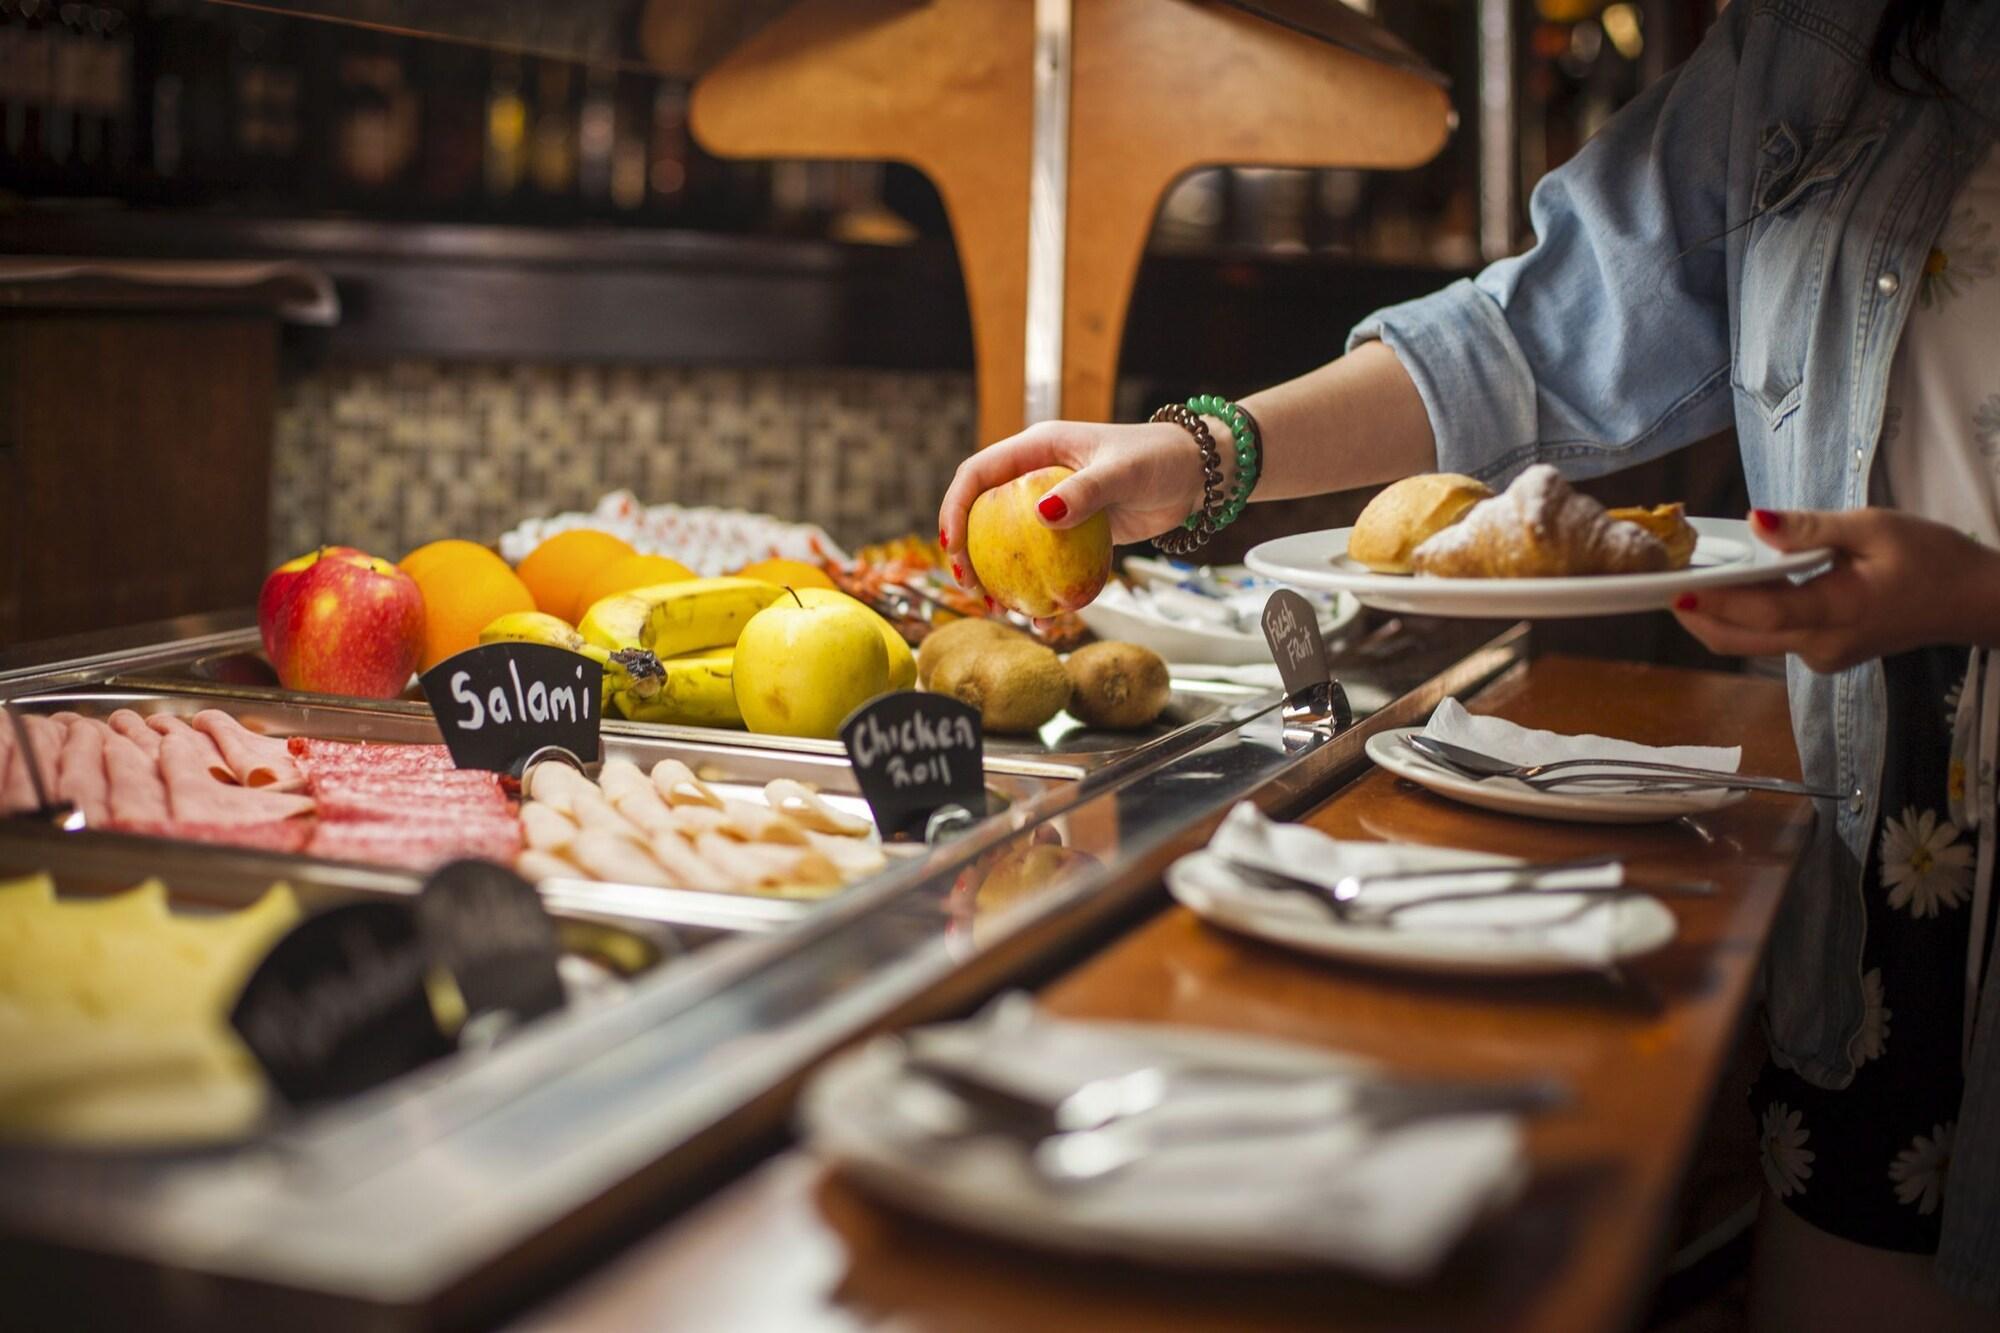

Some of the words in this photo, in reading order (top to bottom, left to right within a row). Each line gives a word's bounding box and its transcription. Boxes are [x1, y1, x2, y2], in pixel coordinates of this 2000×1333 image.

[451, 658, 590, 730] Salami
[852, 709, 977, 769] Chicken
[886, 754, 953, 788] Roll
